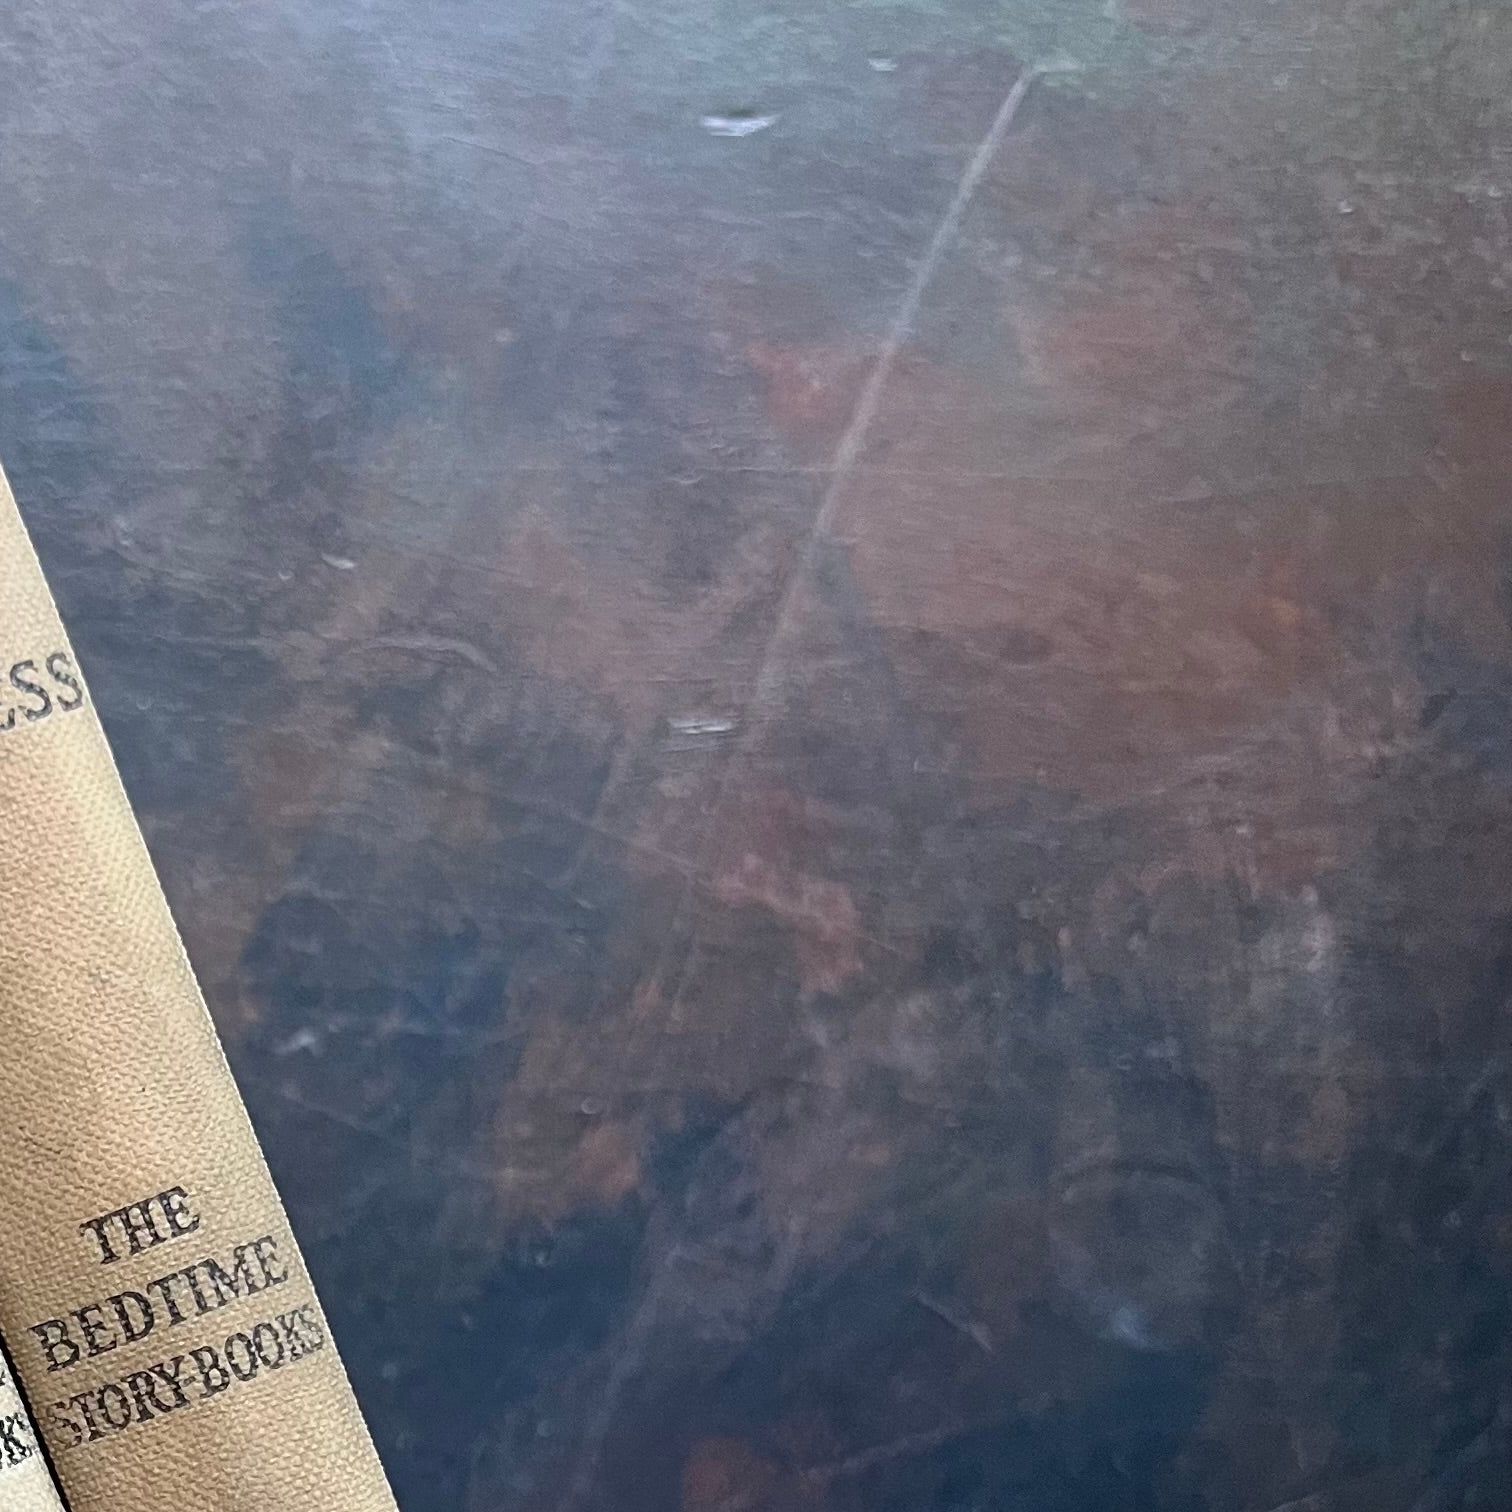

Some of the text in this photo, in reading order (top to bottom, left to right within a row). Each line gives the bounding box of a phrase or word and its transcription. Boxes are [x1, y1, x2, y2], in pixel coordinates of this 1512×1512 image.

[79, 1186, 200, 1264] THE
[28, 1235, 288, 1371] BEDTIME
[46, 1304, 324, 1449] STORY-BOOKS
